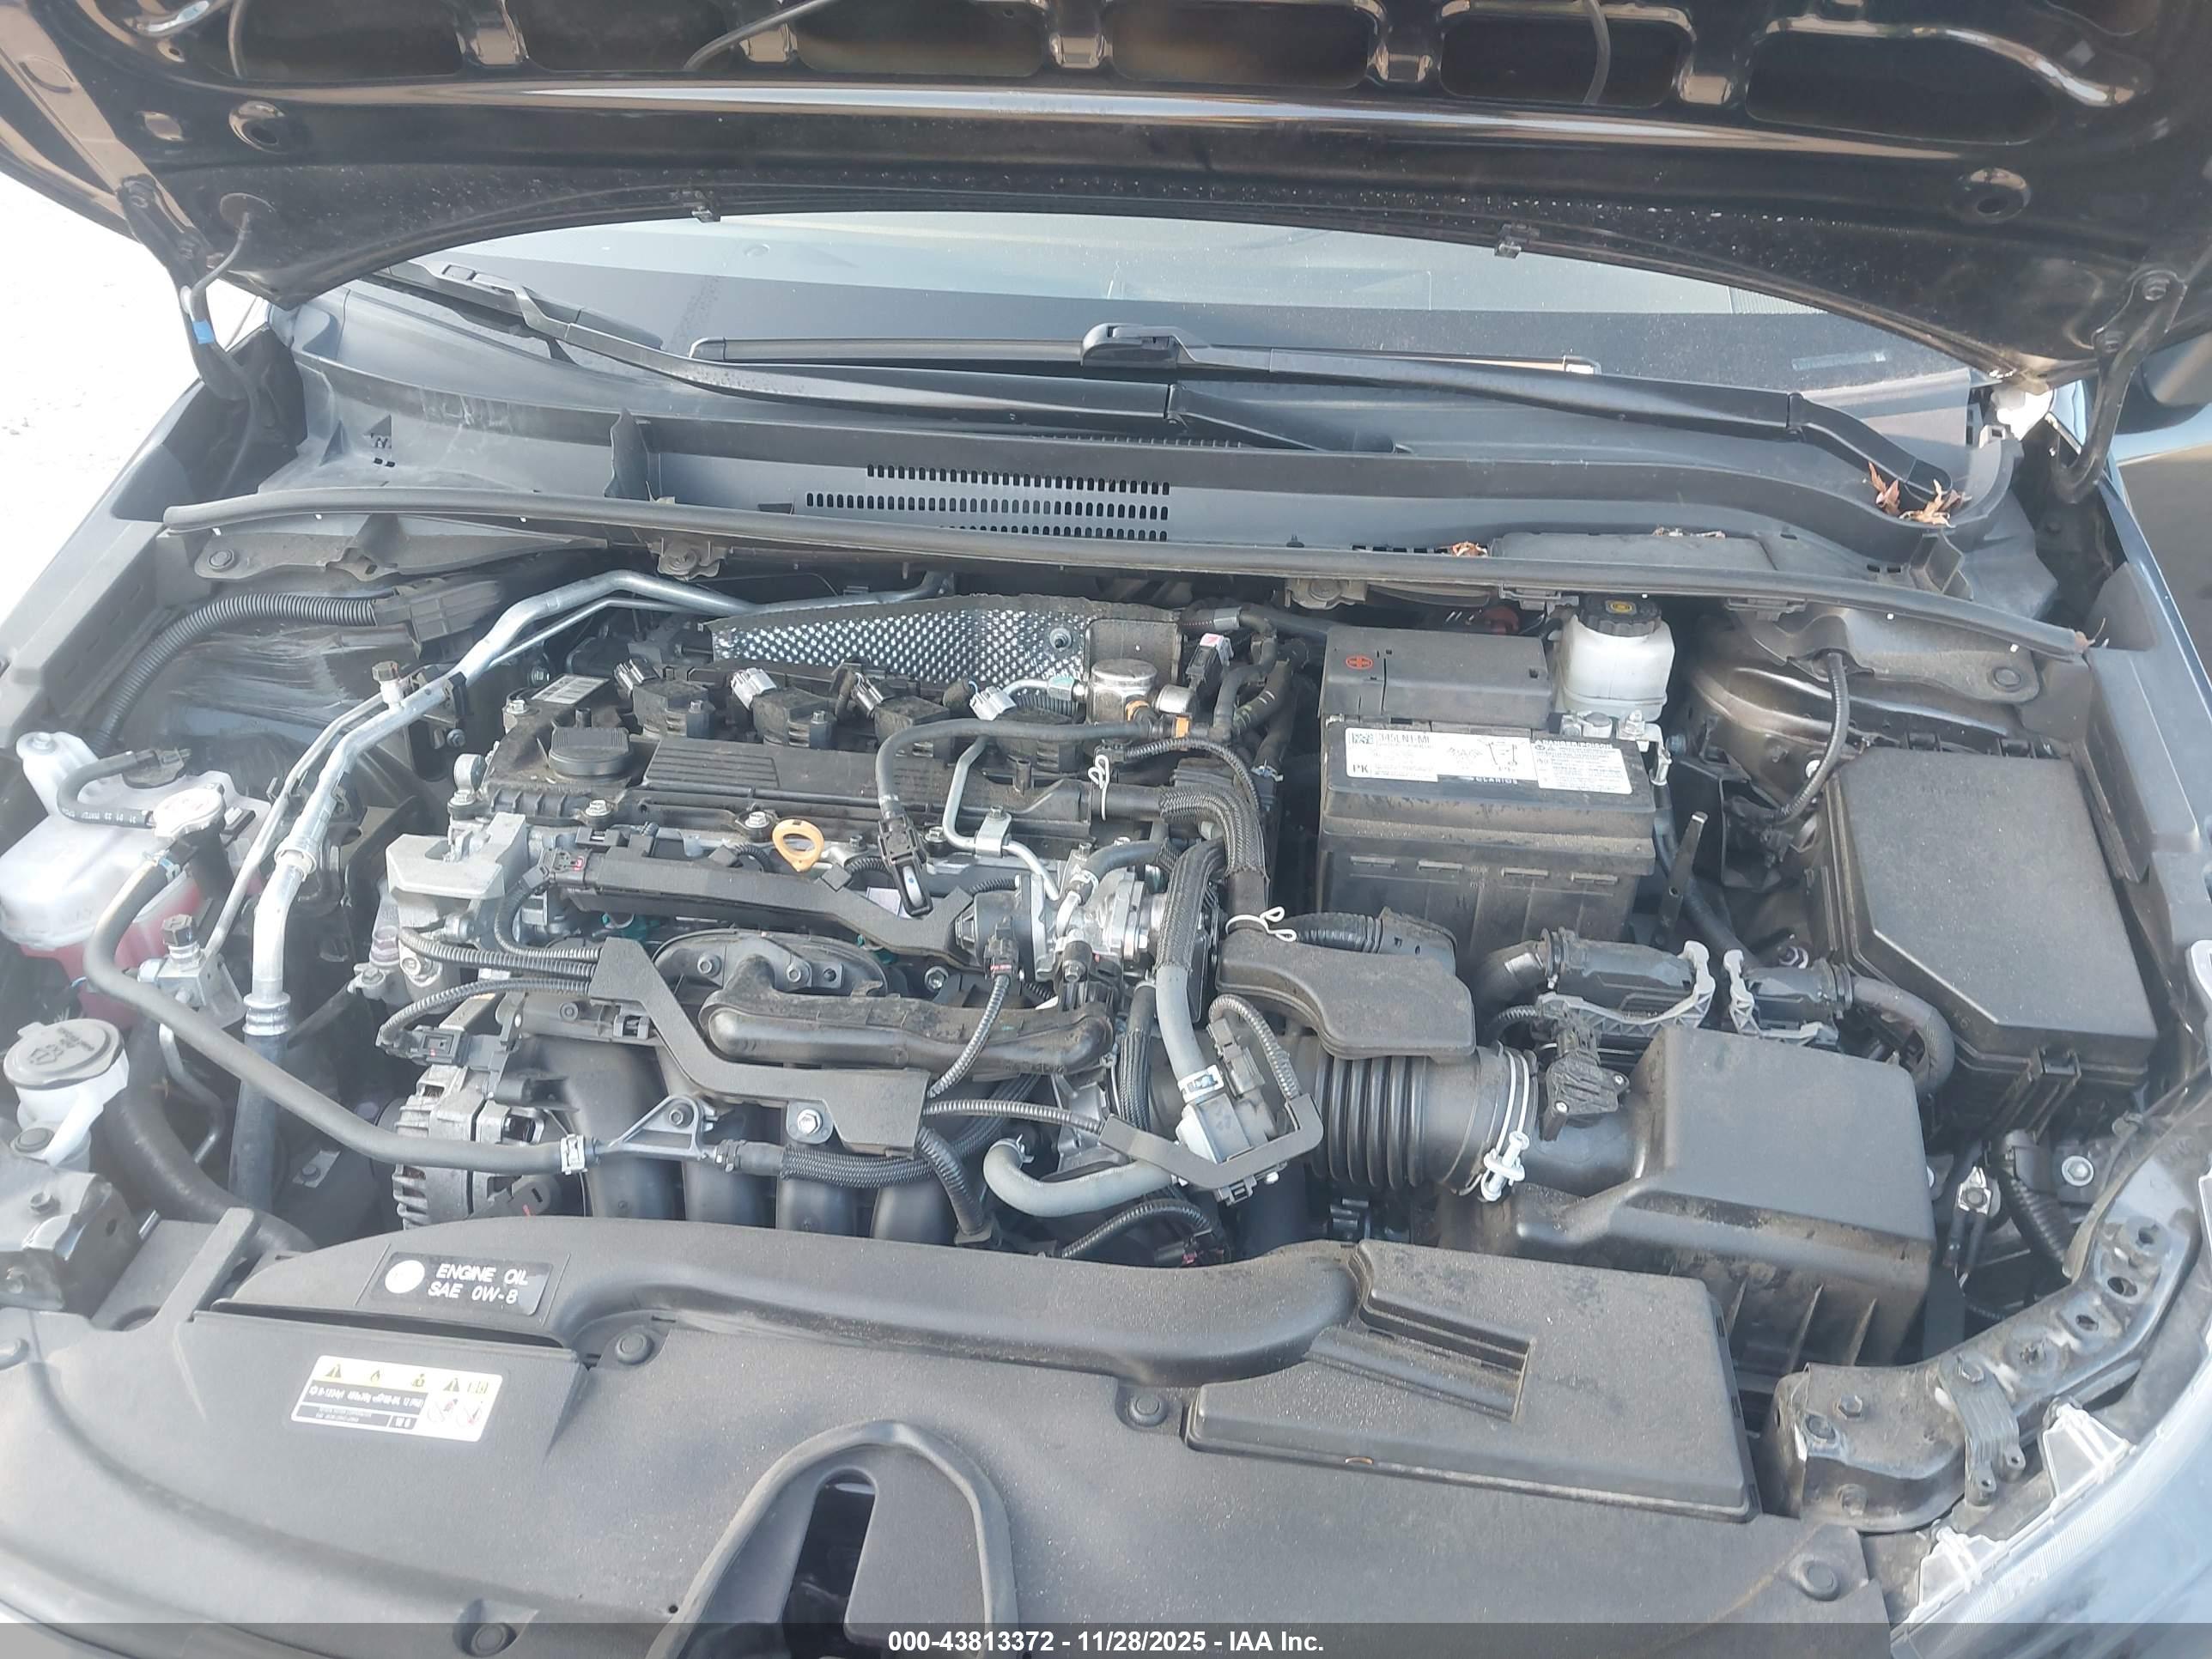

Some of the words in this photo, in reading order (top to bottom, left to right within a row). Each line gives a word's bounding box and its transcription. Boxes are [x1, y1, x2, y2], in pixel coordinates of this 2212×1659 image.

[1352, 763, 1369, 775] PK
[435, 1263, 496, 1283] ENGINE
[503, 1268, 529, 1285] OIL
[428, 1281, 463, 1299] SAE
[471, 1285, 519, 1304] 0W-8
